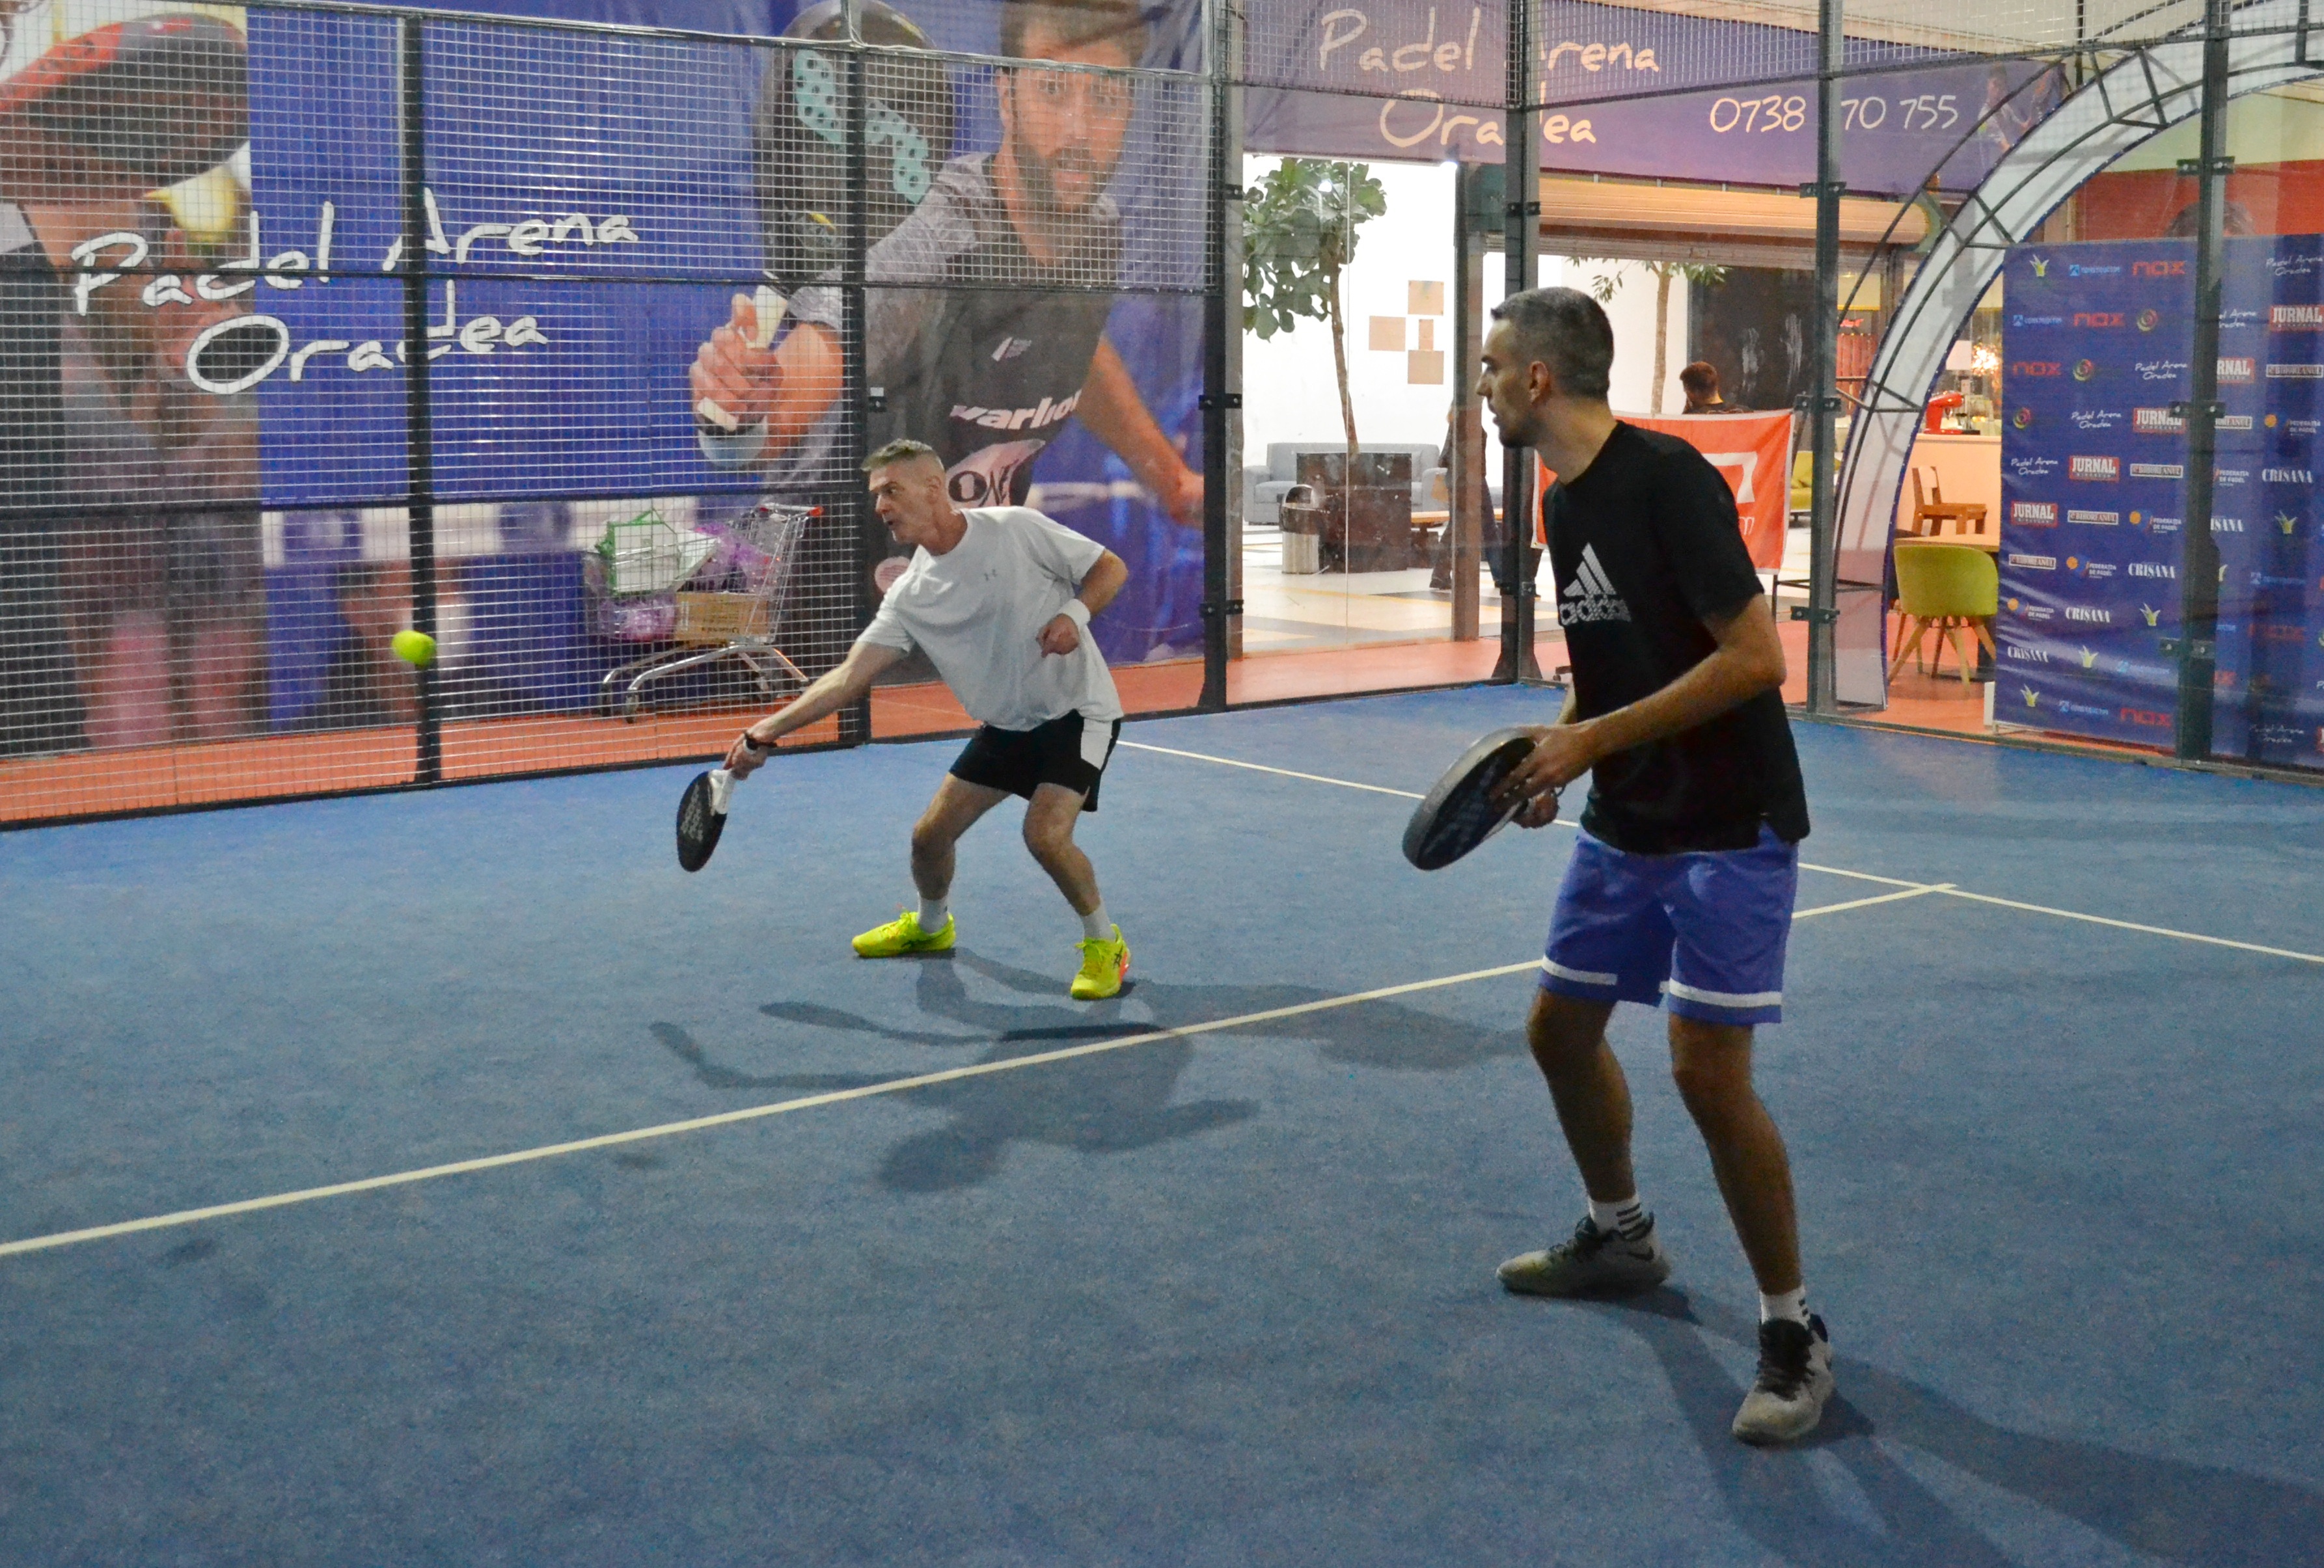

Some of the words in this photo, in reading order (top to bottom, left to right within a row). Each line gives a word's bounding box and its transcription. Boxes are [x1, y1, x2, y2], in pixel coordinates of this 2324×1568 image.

[1319, 5, 1480, 72] Padel
[1505, 40, 1660, 72] rena
[1710, 95, 1806, 133] 0738
[1841, 96, 1887, 130] 70
[1900, 95, 1958, 129] 755
[72, 201, 334, 316] Padel
[2273, 307, 2323, 323] JURNAL
[2217, 360, 2250, 375] RNAL
[2072, 458, 2116, 473] JURNAL
[2014, 503, 2054, 519] JURNAL
